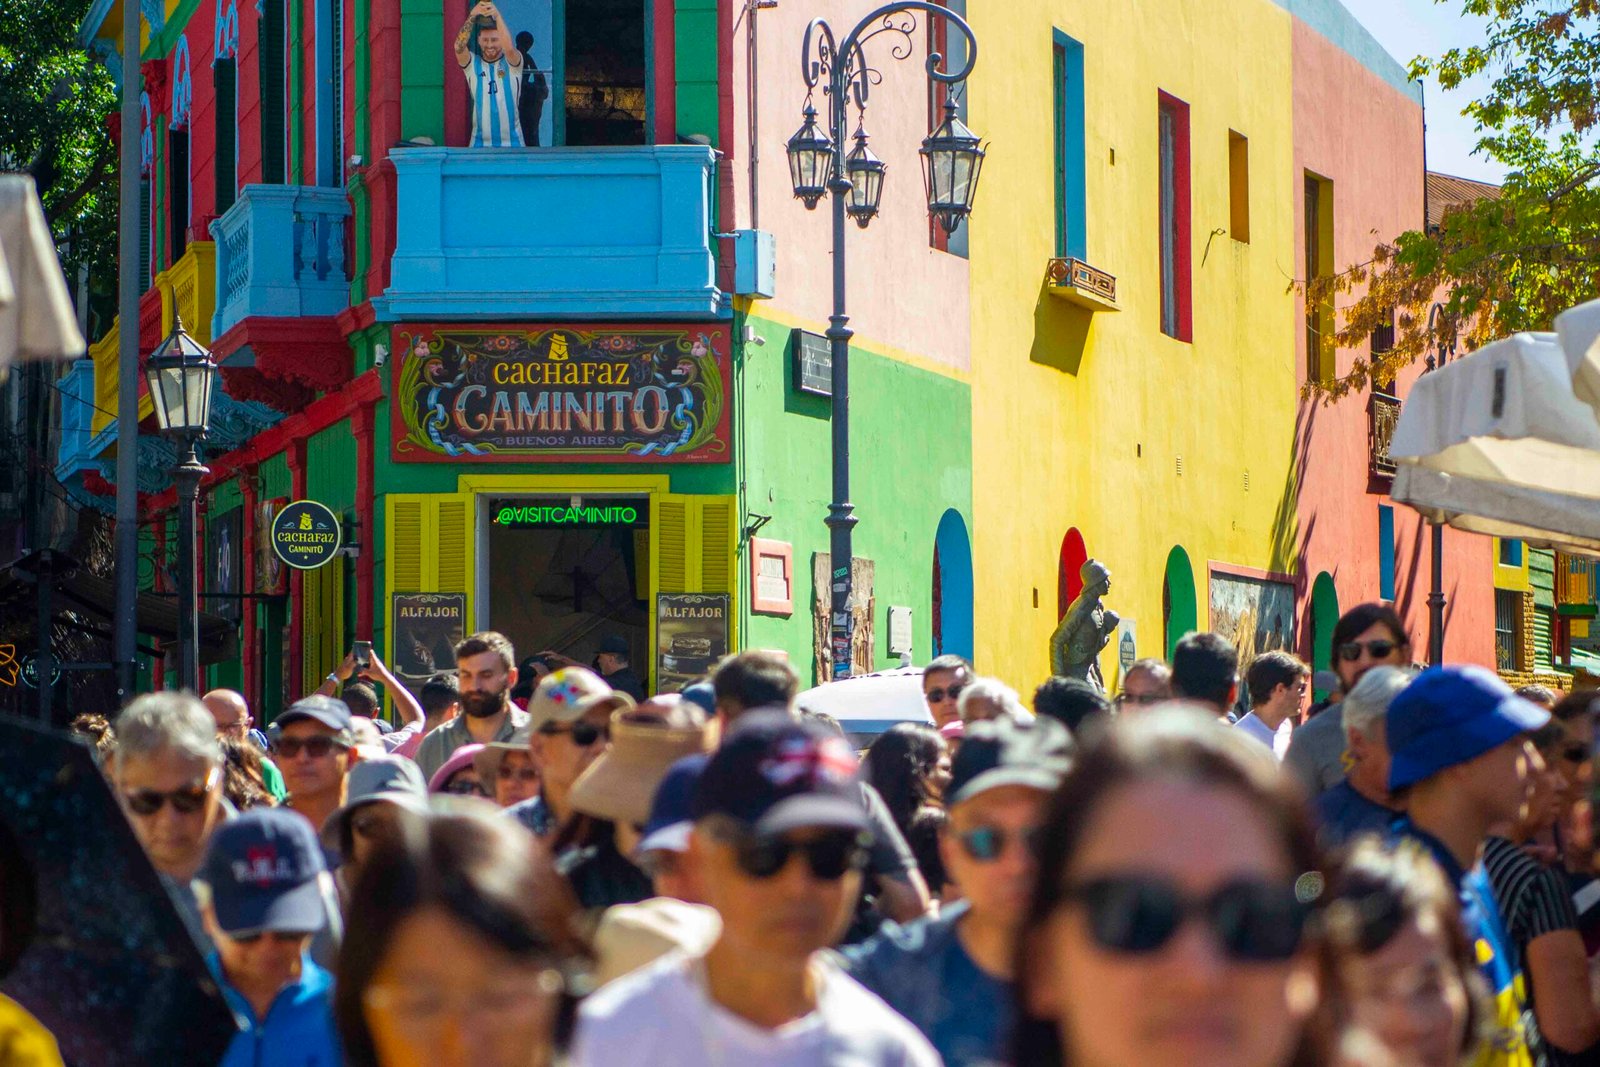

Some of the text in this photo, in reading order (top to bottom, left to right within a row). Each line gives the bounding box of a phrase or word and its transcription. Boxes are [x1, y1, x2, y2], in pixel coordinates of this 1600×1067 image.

[453, 385, 669, 434] CAMINITO
[505, 435, 616, 446] BUENOS AIRES
[498, 506, 637, 525] @VISITCAMINITO
[288, 544, 324, 554] CAMINITO
[400, 606, 459, 617] ALFAJOR
[665, 607, 723, 618] ALFAJOR
